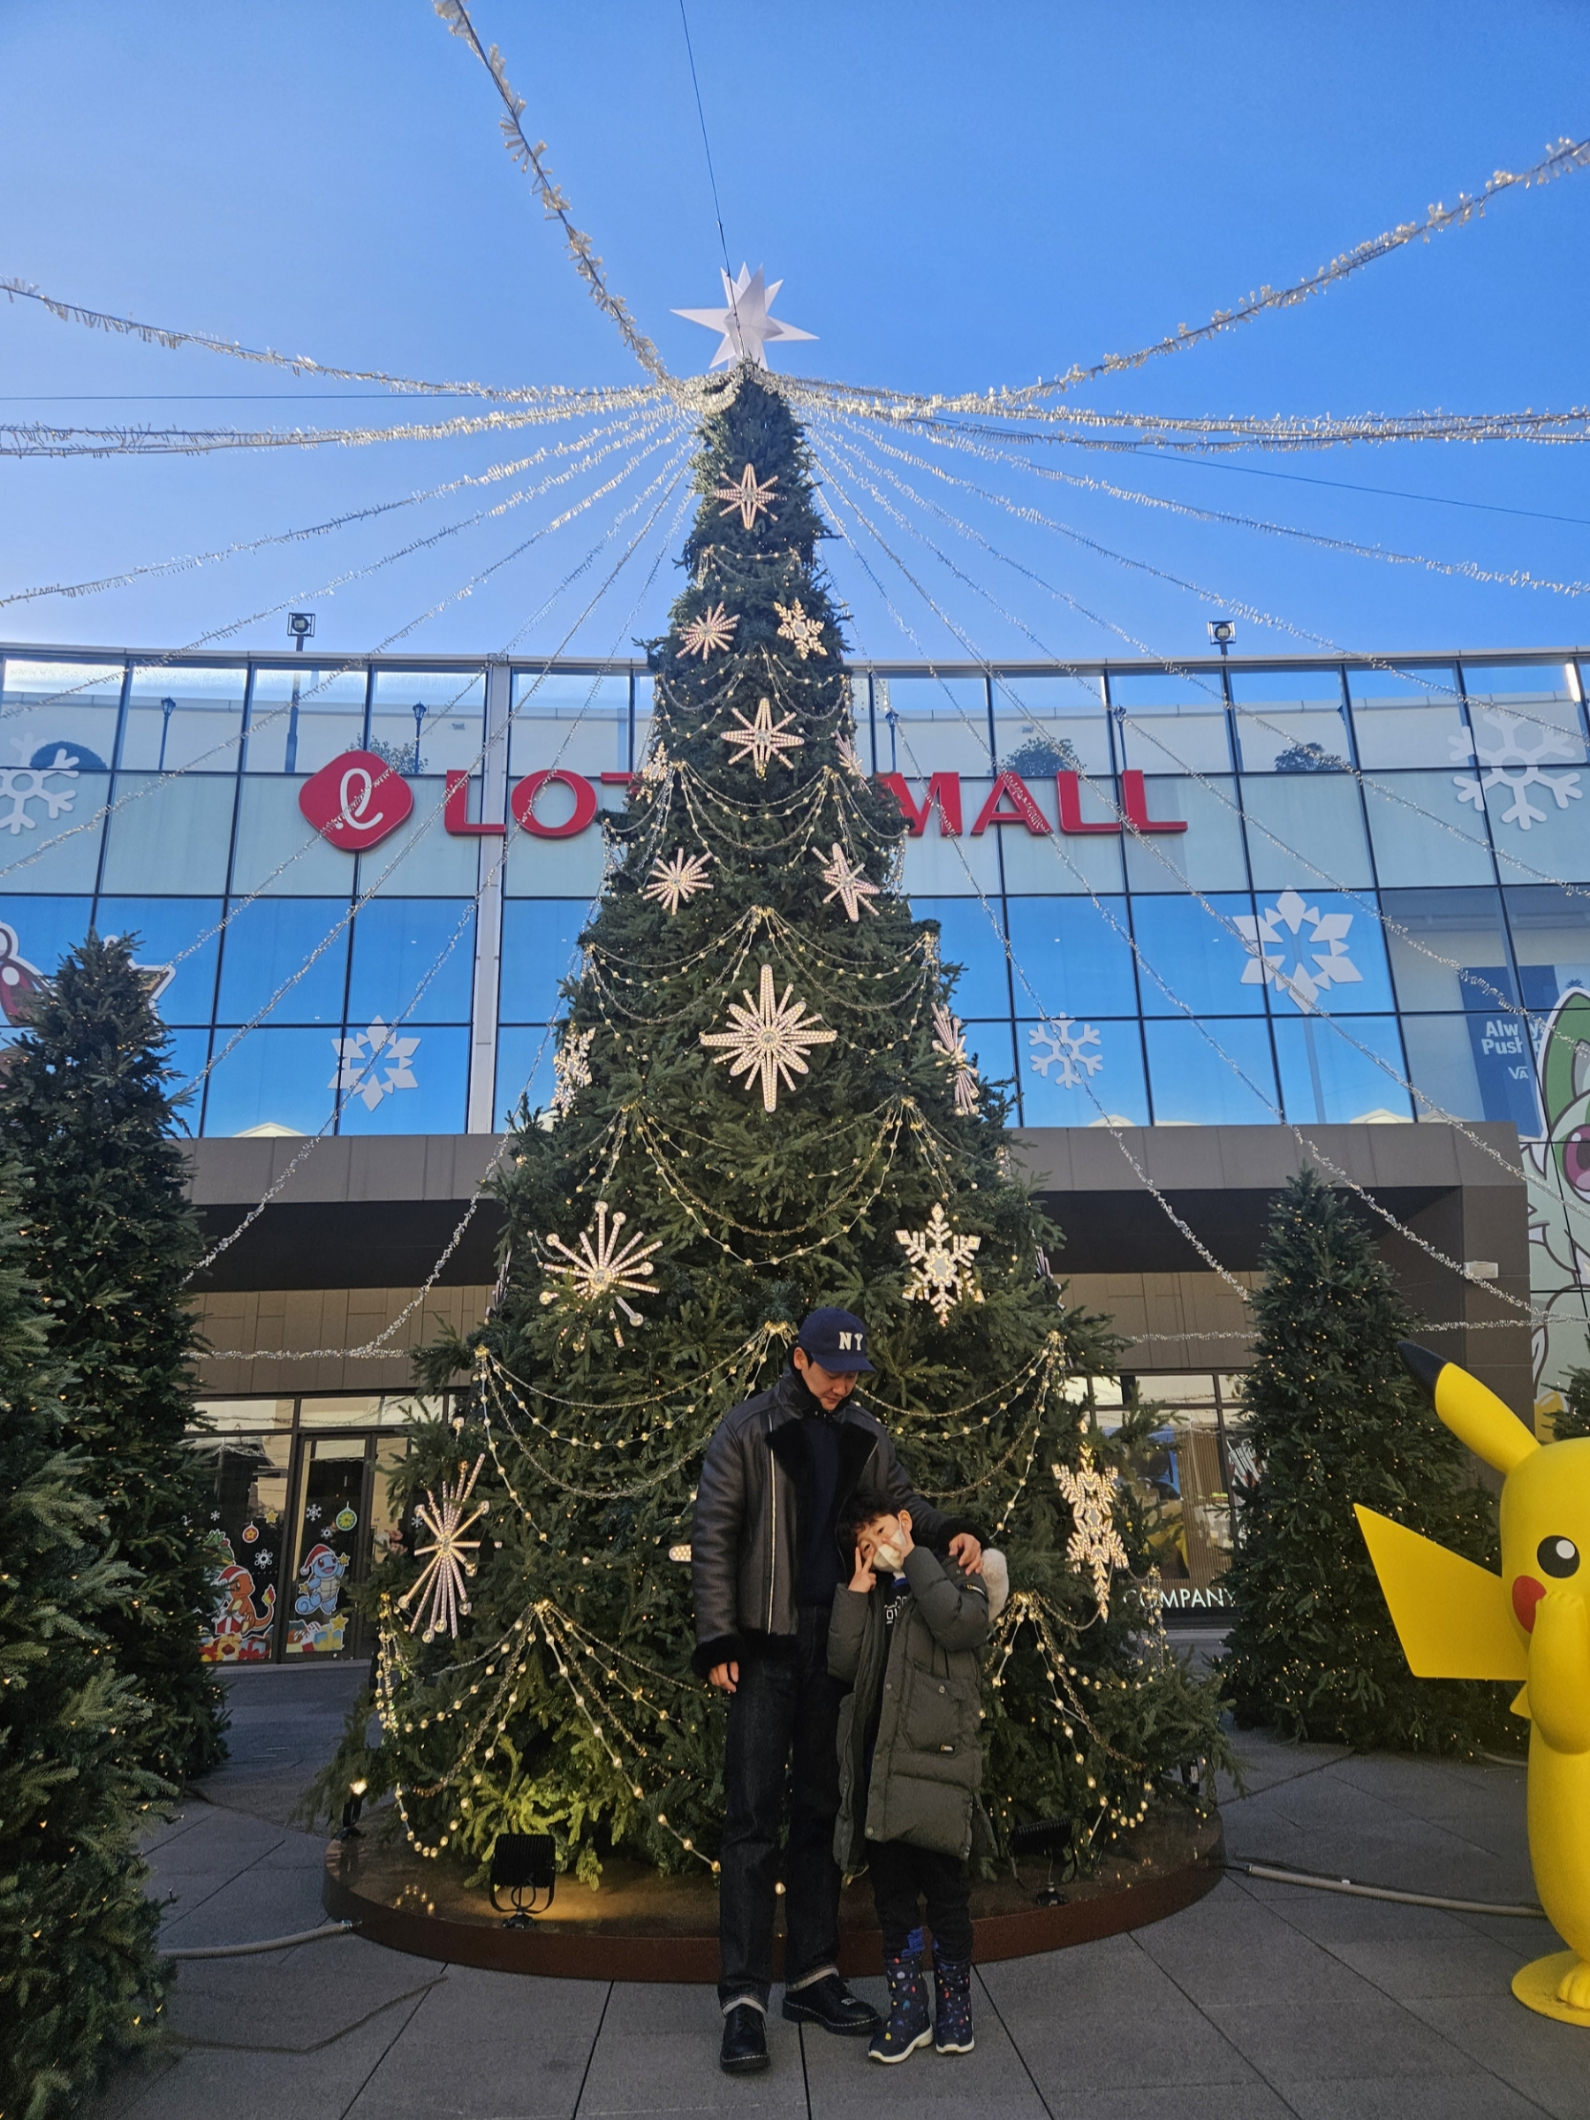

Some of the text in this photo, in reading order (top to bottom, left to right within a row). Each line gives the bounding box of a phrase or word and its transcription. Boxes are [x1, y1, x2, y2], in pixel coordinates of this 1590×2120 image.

[875, 769, 1188, 836] MALL
[1486, 1019, 1545, 1039] Alwy
[839, 1331, 864, 1351] NY
